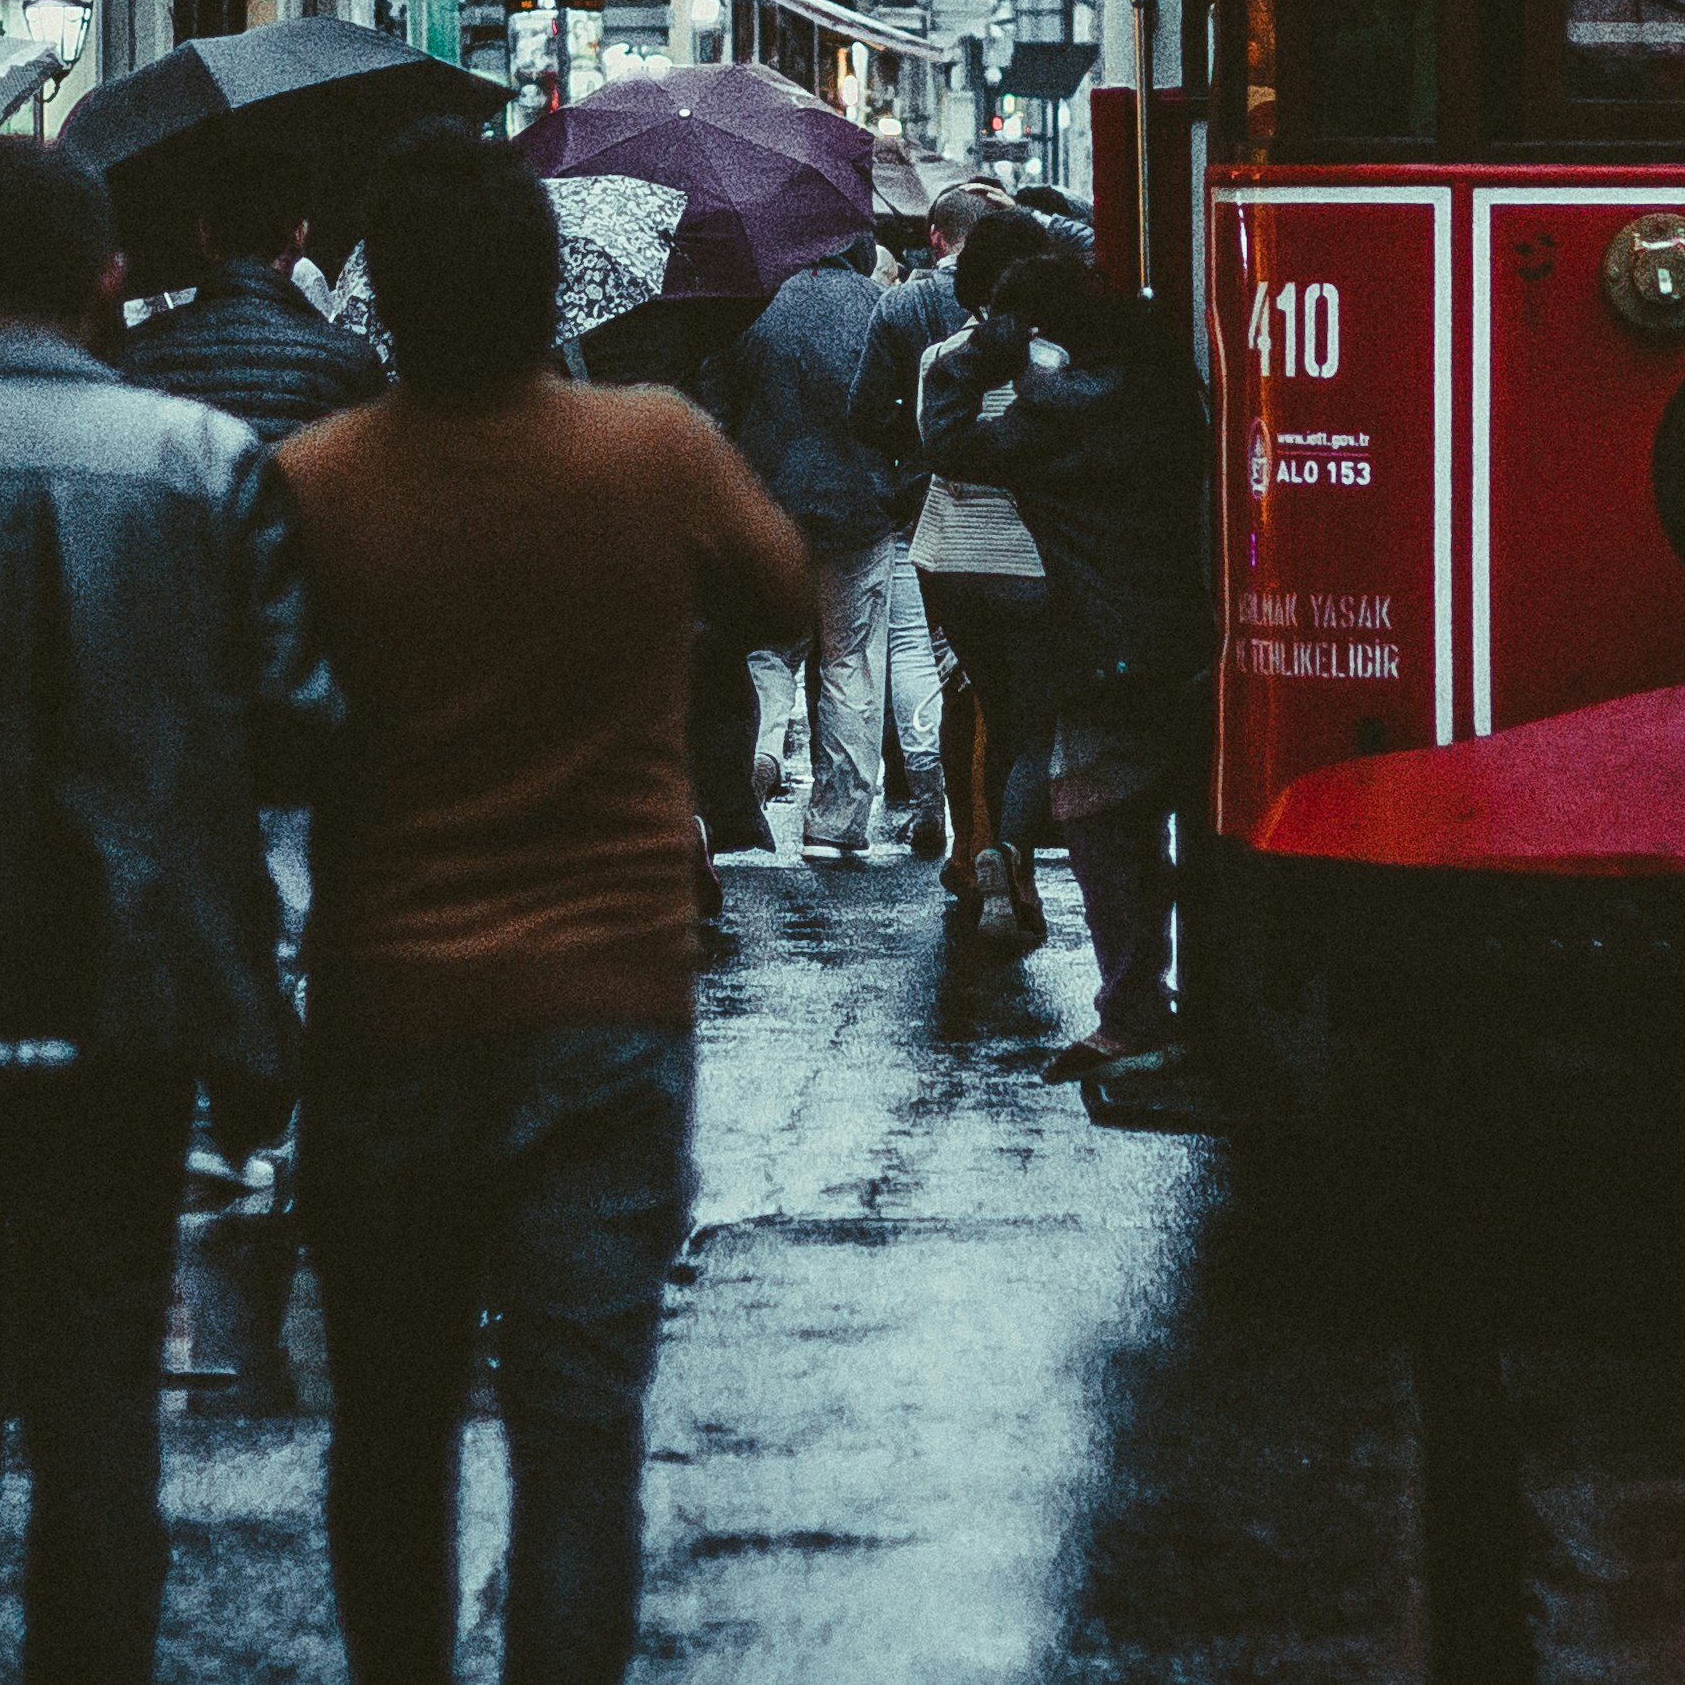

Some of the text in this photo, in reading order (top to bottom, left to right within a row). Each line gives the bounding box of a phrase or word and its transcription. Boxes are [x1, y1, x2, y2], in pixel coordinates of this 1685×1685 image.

[1248, 280, 1340, 380] 410
[1276, 459, 1319, 484] ALO
[1327, 460, 1371, 486] 153
[1309, 594, 1393, 631] YASAK
